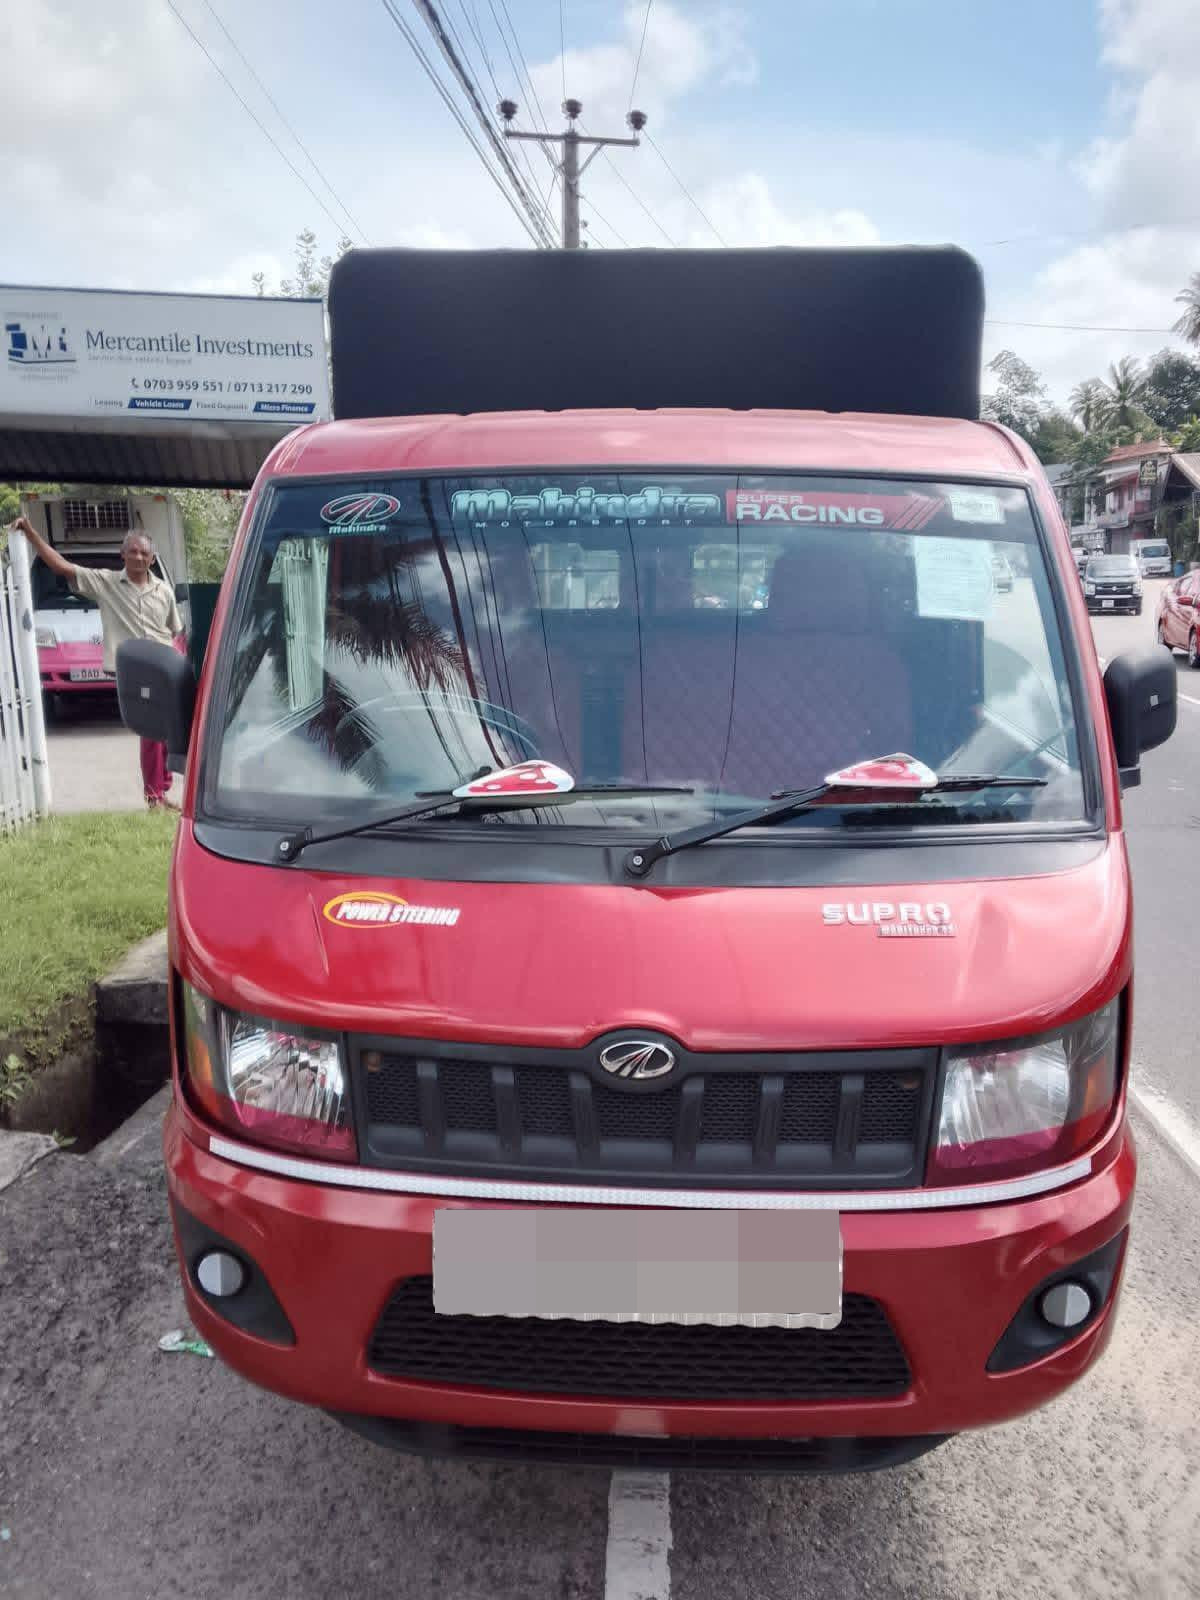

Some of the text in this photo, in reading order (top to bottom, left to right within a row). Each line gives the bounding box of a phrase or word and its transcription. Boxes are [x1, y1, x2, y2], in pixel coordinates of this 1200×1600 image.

[86, 329, 313, 358] Mercantile Investments
[143, 378, 174, 390] 0703
[176, 380, 199, 391] 959
[203, 380, 224, 393] 551
[234, 382, 263, 393] 0713
[266, 383, 287, 394] 217
[291, 383, 313, 395] 290
[135, 399, 162, 409] Vehicle
[736, 493, 803, 505] SUPER
[736, 503, 884, 524] RACING
[329, 524, 387, 534] Mahindra
[336, 901, 461, 926] POWER STEERING
[821, 902, 952, 925] SUPRO
